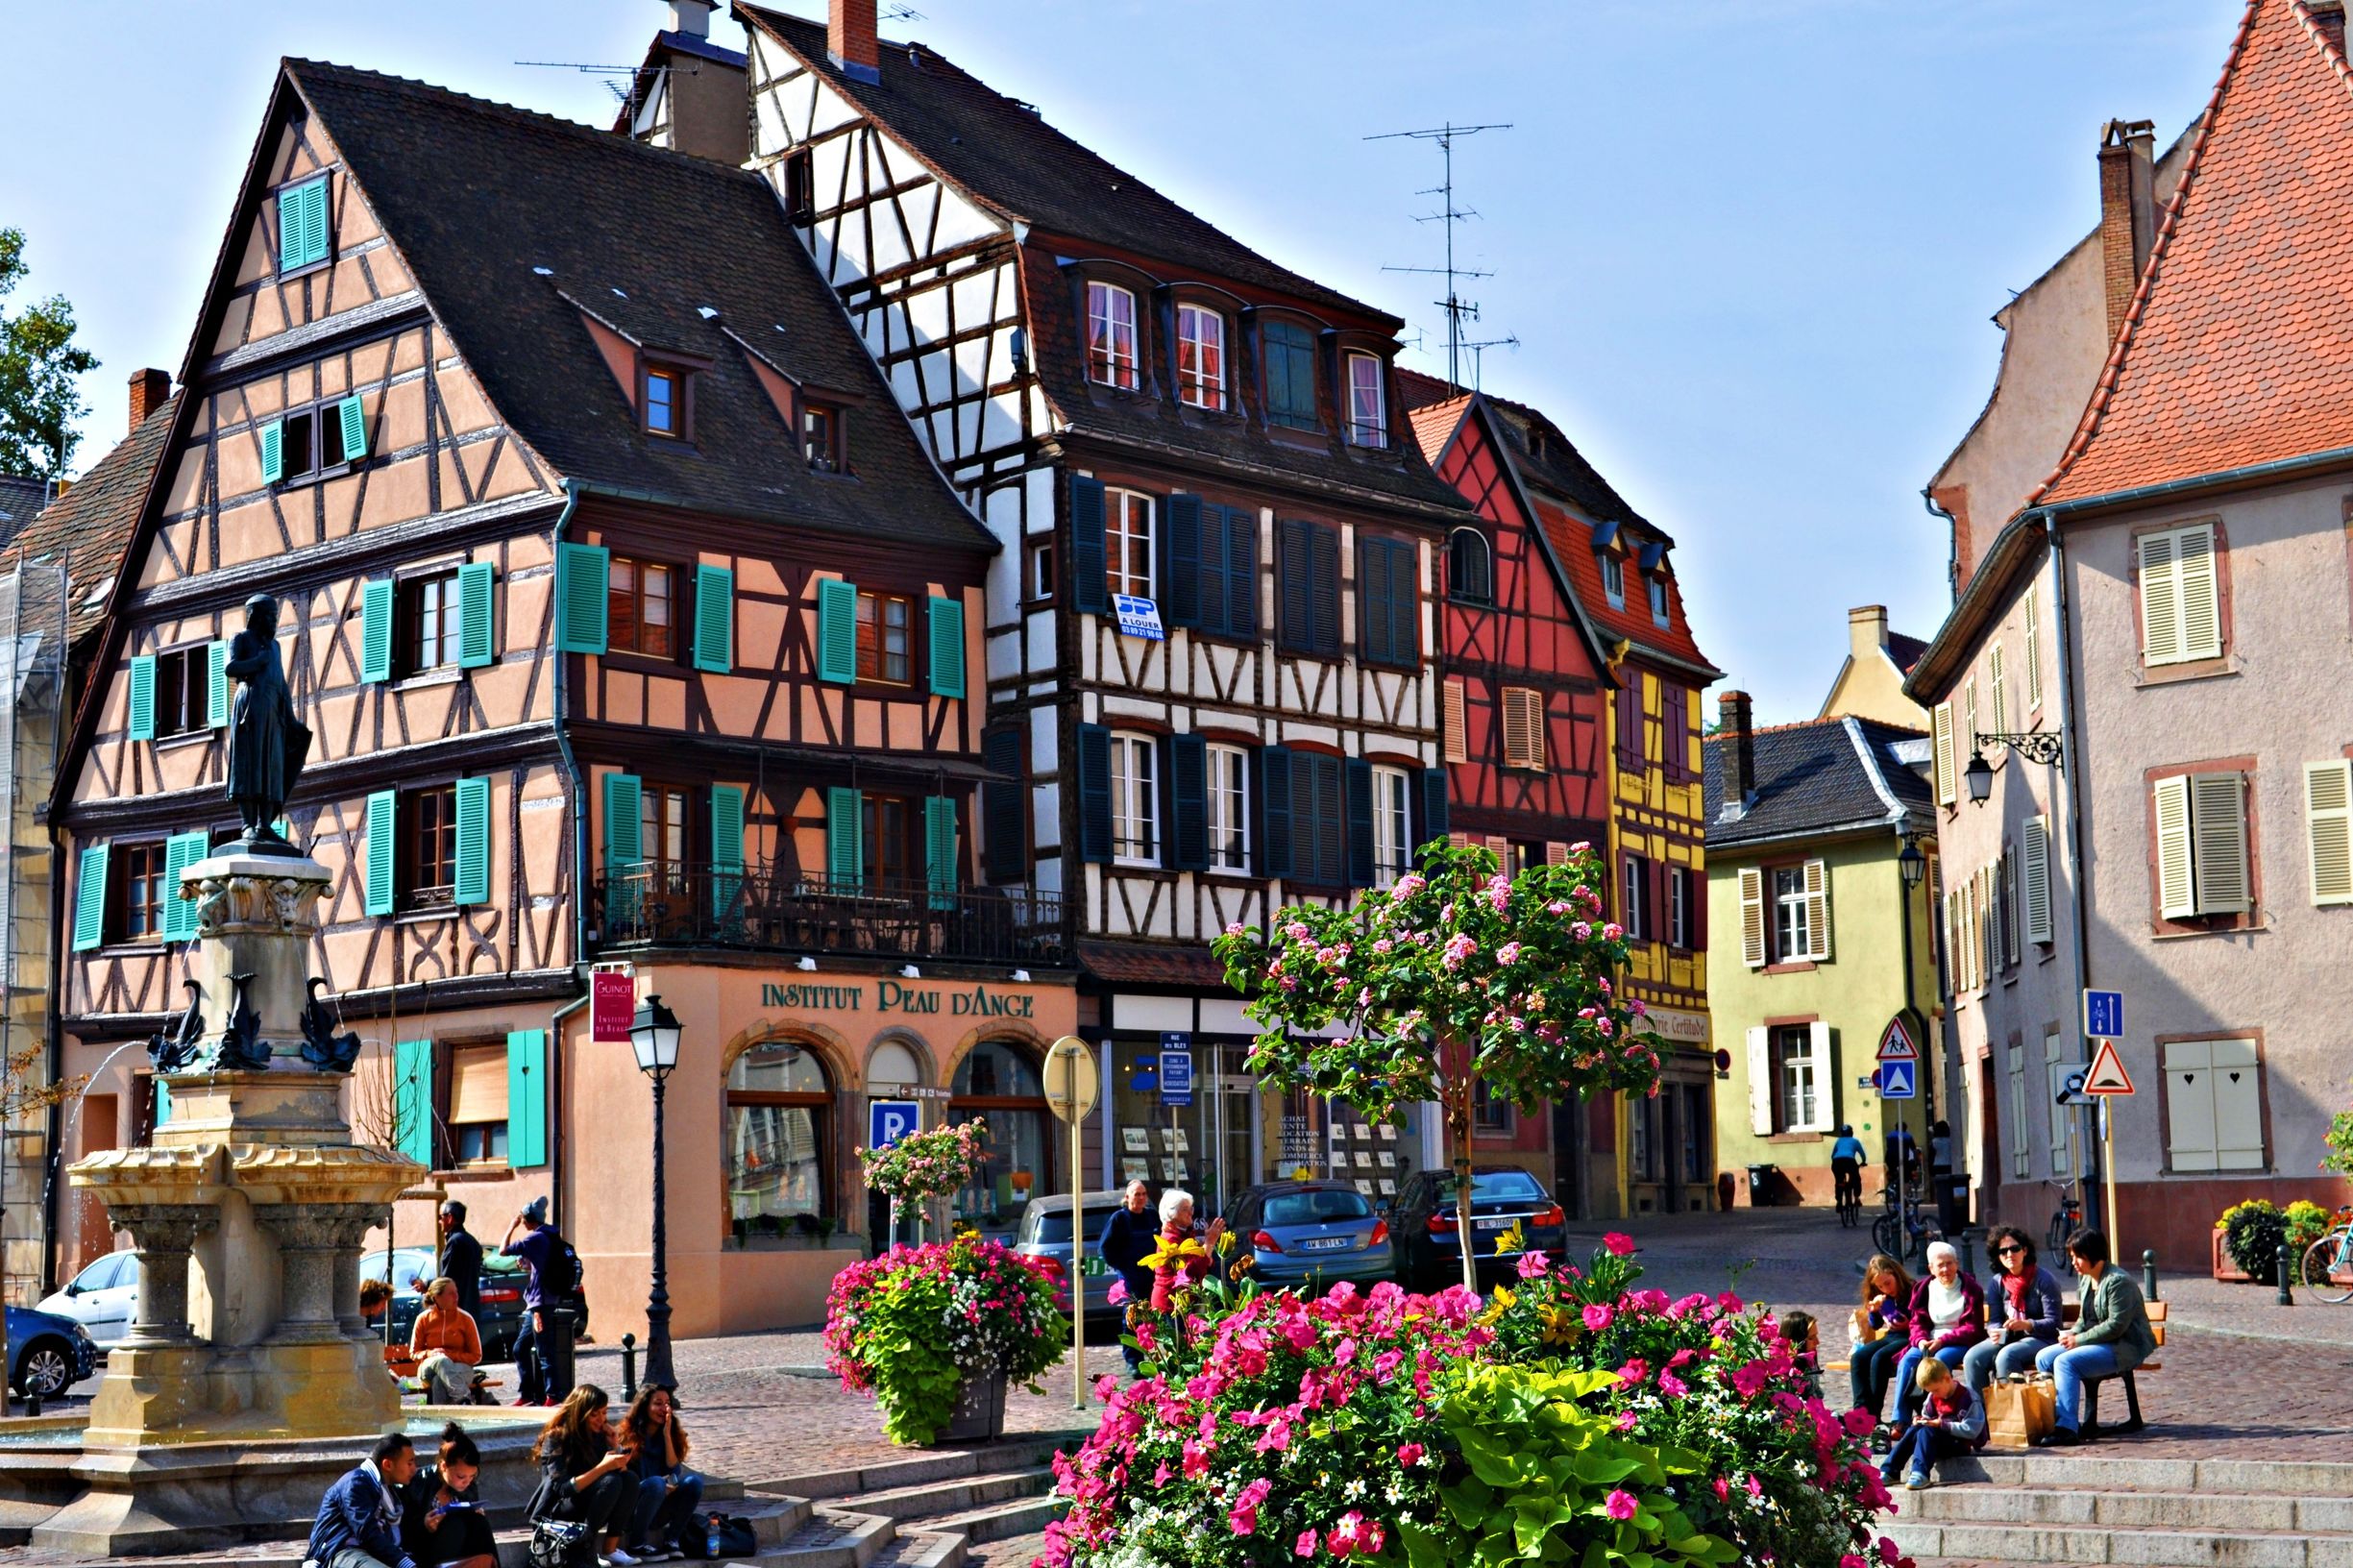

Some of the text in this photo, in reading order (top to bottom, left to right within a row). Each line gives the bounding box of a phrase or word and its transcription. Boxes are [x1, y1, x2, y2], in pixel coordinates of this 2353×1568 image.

[1130, 619, 1160, 629] LOUER
[596, 981, 632, 994] GUINOT
[762, 980, 1034, 1018] INSTITUT PEAU D'ANGE
[599, 1015, 629, 1024] INSTITUT
[1671, 1017, 1704, 1037] Certitude
[884, 1112, 905, 1142] P
